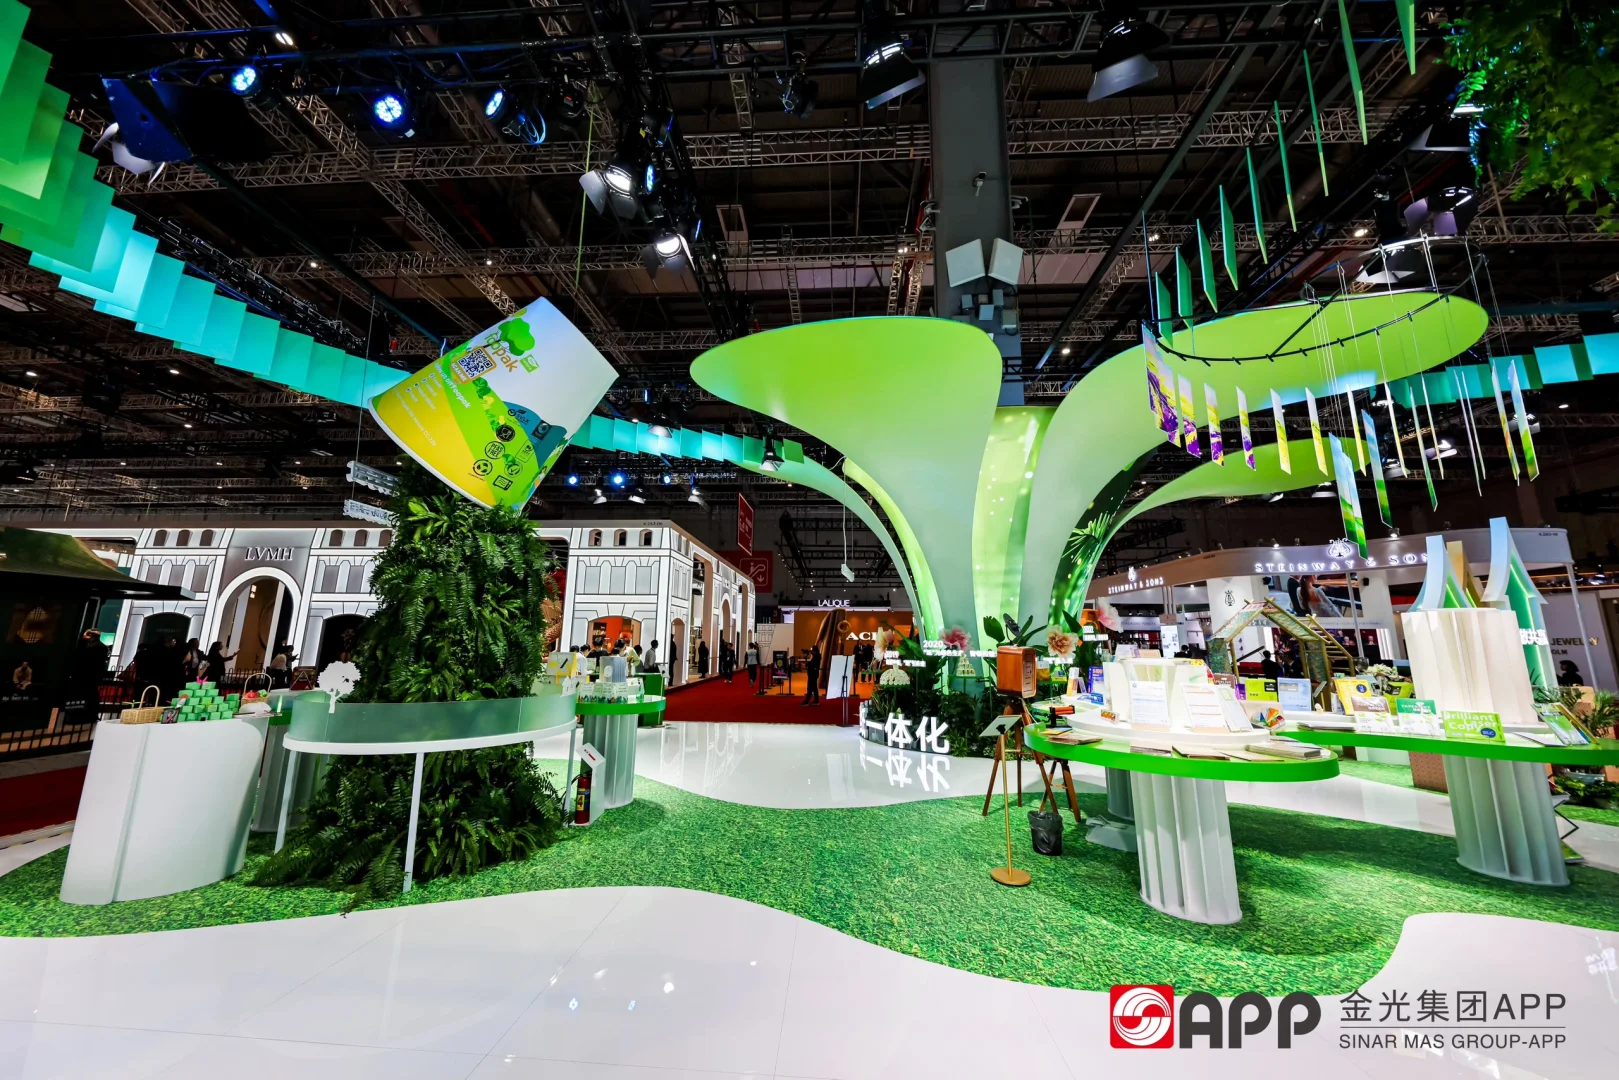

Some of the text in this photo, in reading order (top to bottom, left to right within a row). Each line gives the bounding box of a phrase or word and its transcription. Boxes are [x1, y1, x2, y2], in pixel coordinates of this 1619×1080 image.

[244, 546, 294, 561] LVMH
[1254, 559, 1356, 573] STEINWAY
[817, 599, 850, 608] LALIQUE
